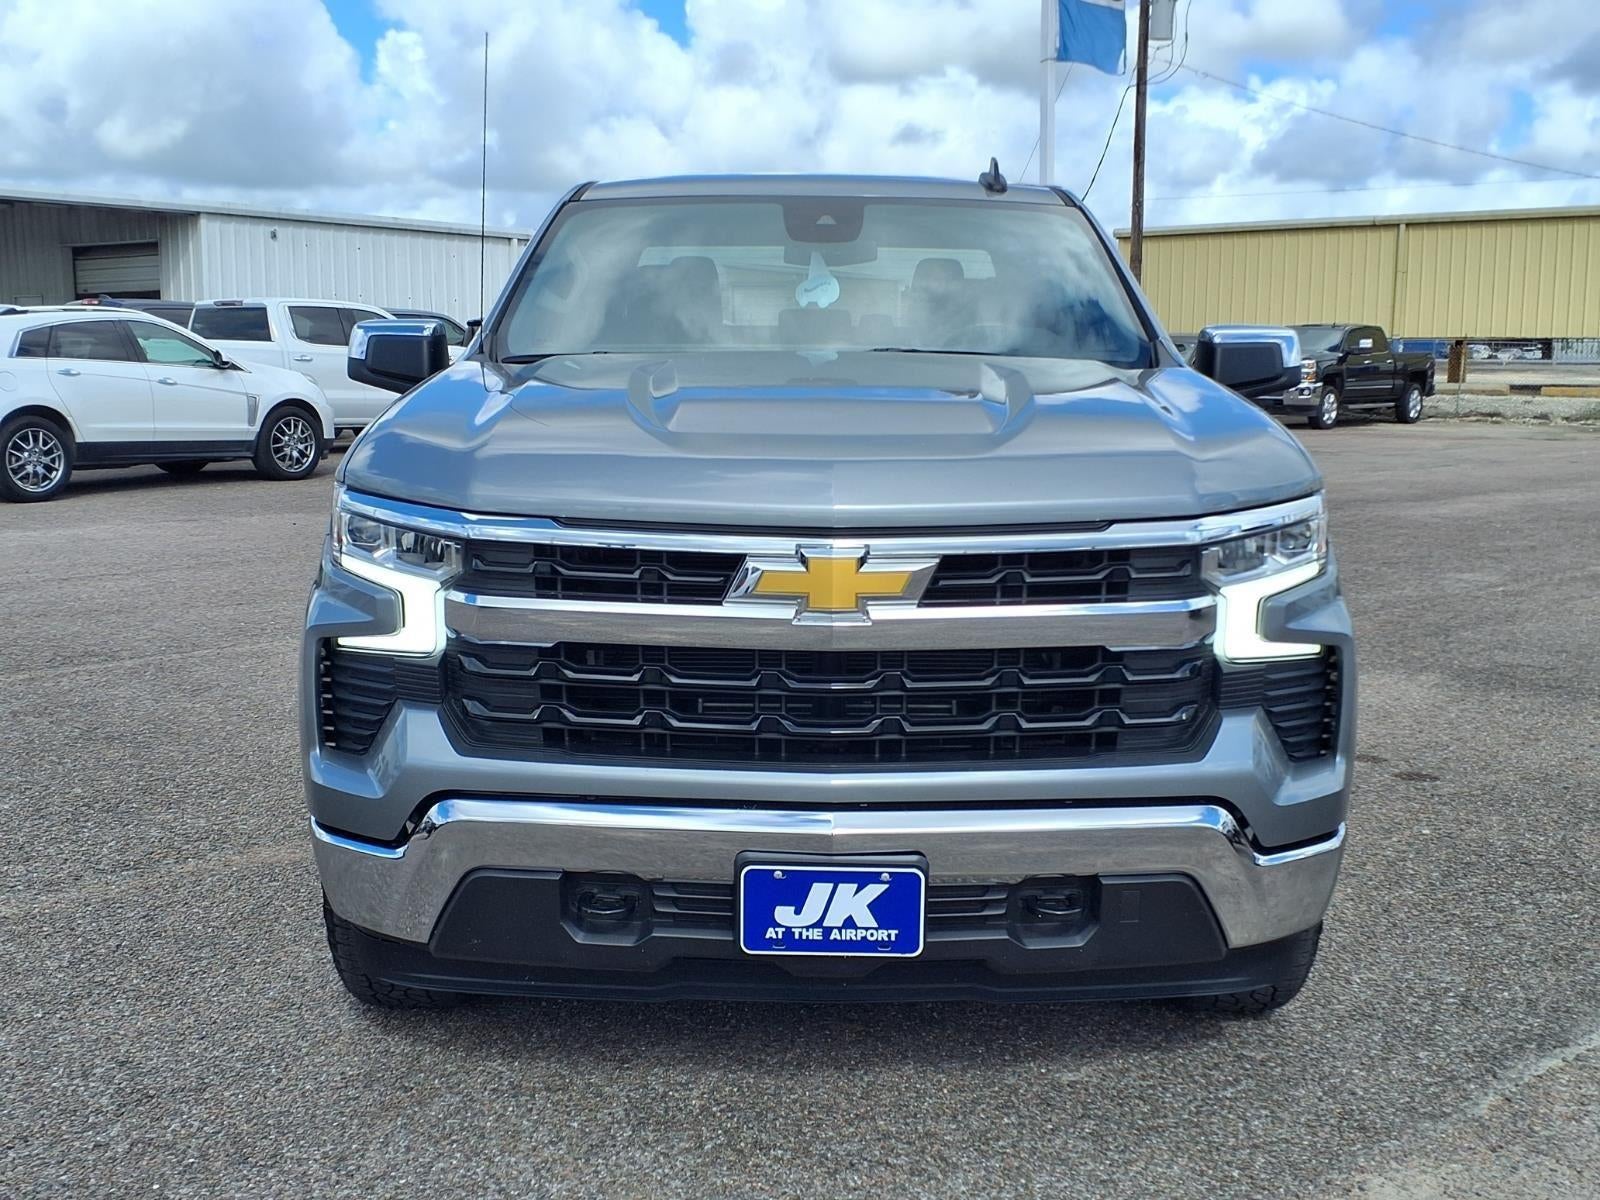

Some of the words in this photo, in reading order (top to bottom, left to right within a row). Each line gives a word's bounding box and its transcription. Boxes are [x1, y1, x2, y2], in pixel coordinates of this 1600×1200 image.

[774, 882, 890, 928] JK
[765, 927, 786, 939] AT
[791, 928, 823, 940] THE
[829, 929, 899, 942] AIRPORT
